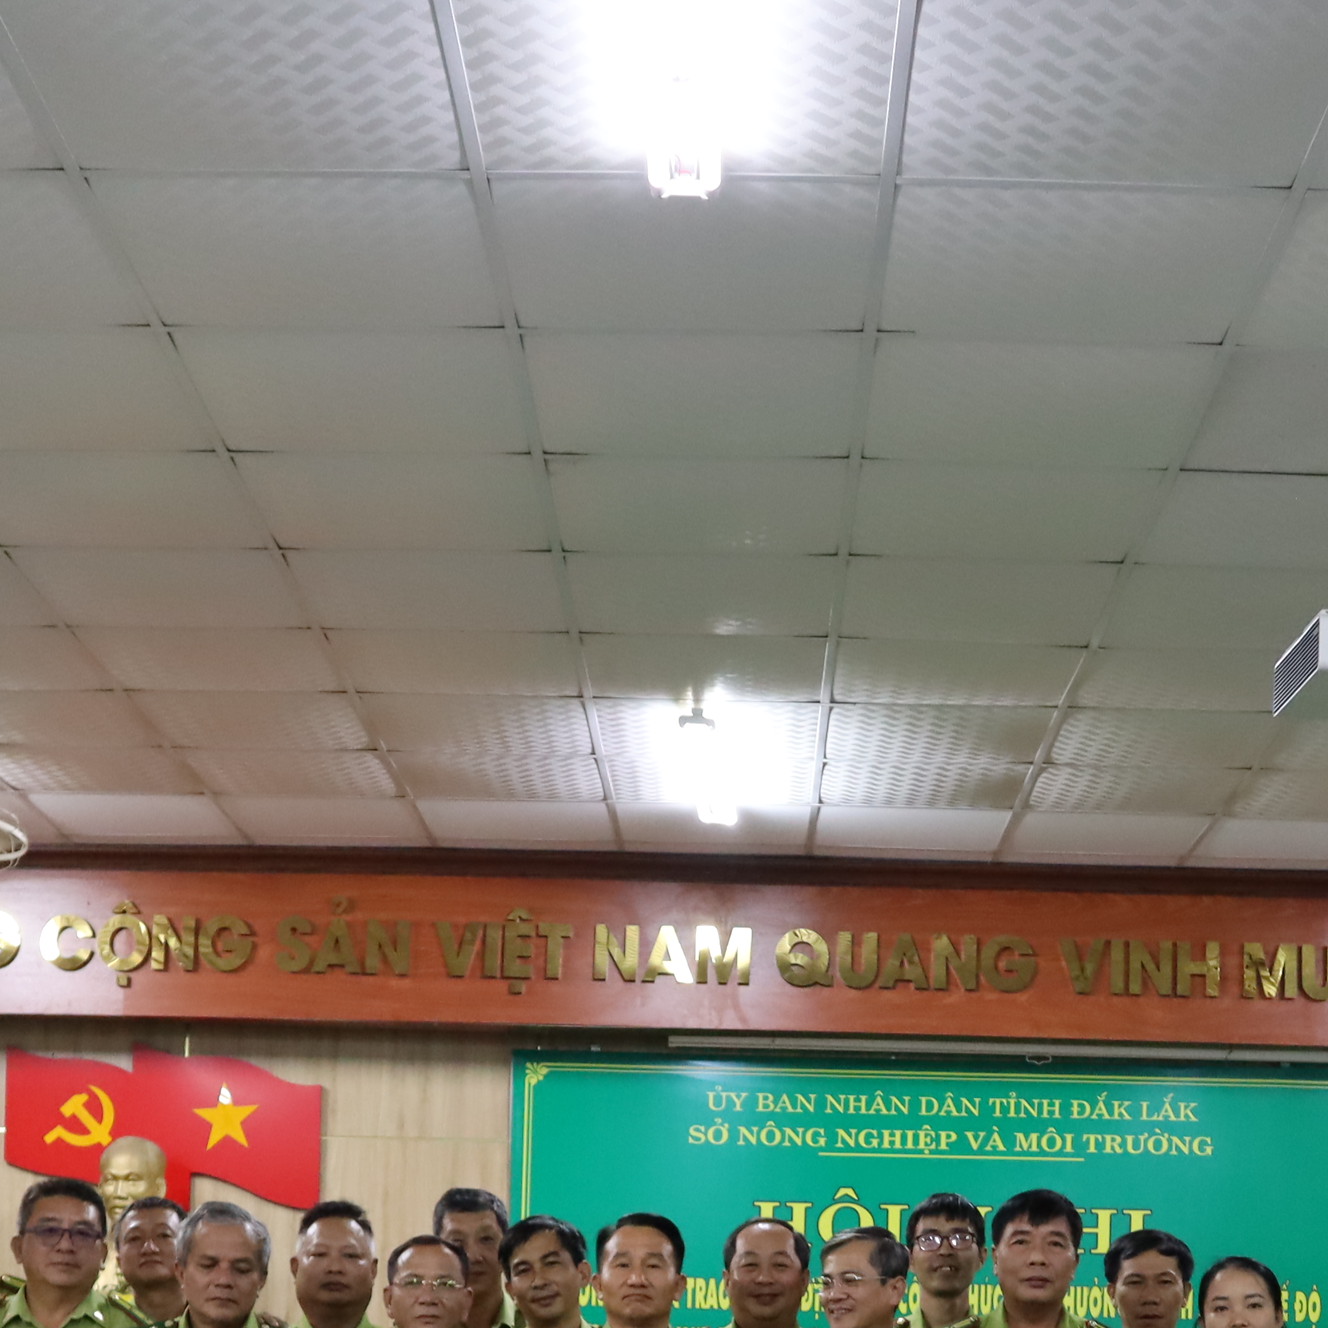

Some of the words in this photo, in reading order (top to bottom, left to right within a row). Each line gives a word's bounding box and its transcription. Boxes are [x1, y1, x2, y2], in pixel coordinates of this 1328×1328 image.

[39, 900, 256, 988] CỘNG
[275, 895, 411, 977] SẢN
[435, 907, 572, 995] VIỆT
[593, 923, 753, 985] NAM
[775, 928, 1038, 993] QUANG
[1059, 938, 1221, 998] VINH
[707, 1085, 750, 1112] ỦY
[756, 1092, 816, 1113] BAN
[825, 1089, 911, 1115] NHÂN
[918, 1092, 981, 1117] DÂN
[988, 1091, 1062, 1118] TỈNH
[1070, 1091, 1132, 1120] ĐẮK
[1139, 1093, 1200, 1122] LẮK
[688, 1118, 730, 1144] SỞ
[737, 1121, 826, 1147] NÔNG
[835, 1124, 958, 1154] NGHIỆP
[964, 1125, 1007, 1151] VÀ
[1014, 1127, 1075, 1153] MÔI
[1082, 1128, 1215, 1156] TRƯỜNG
